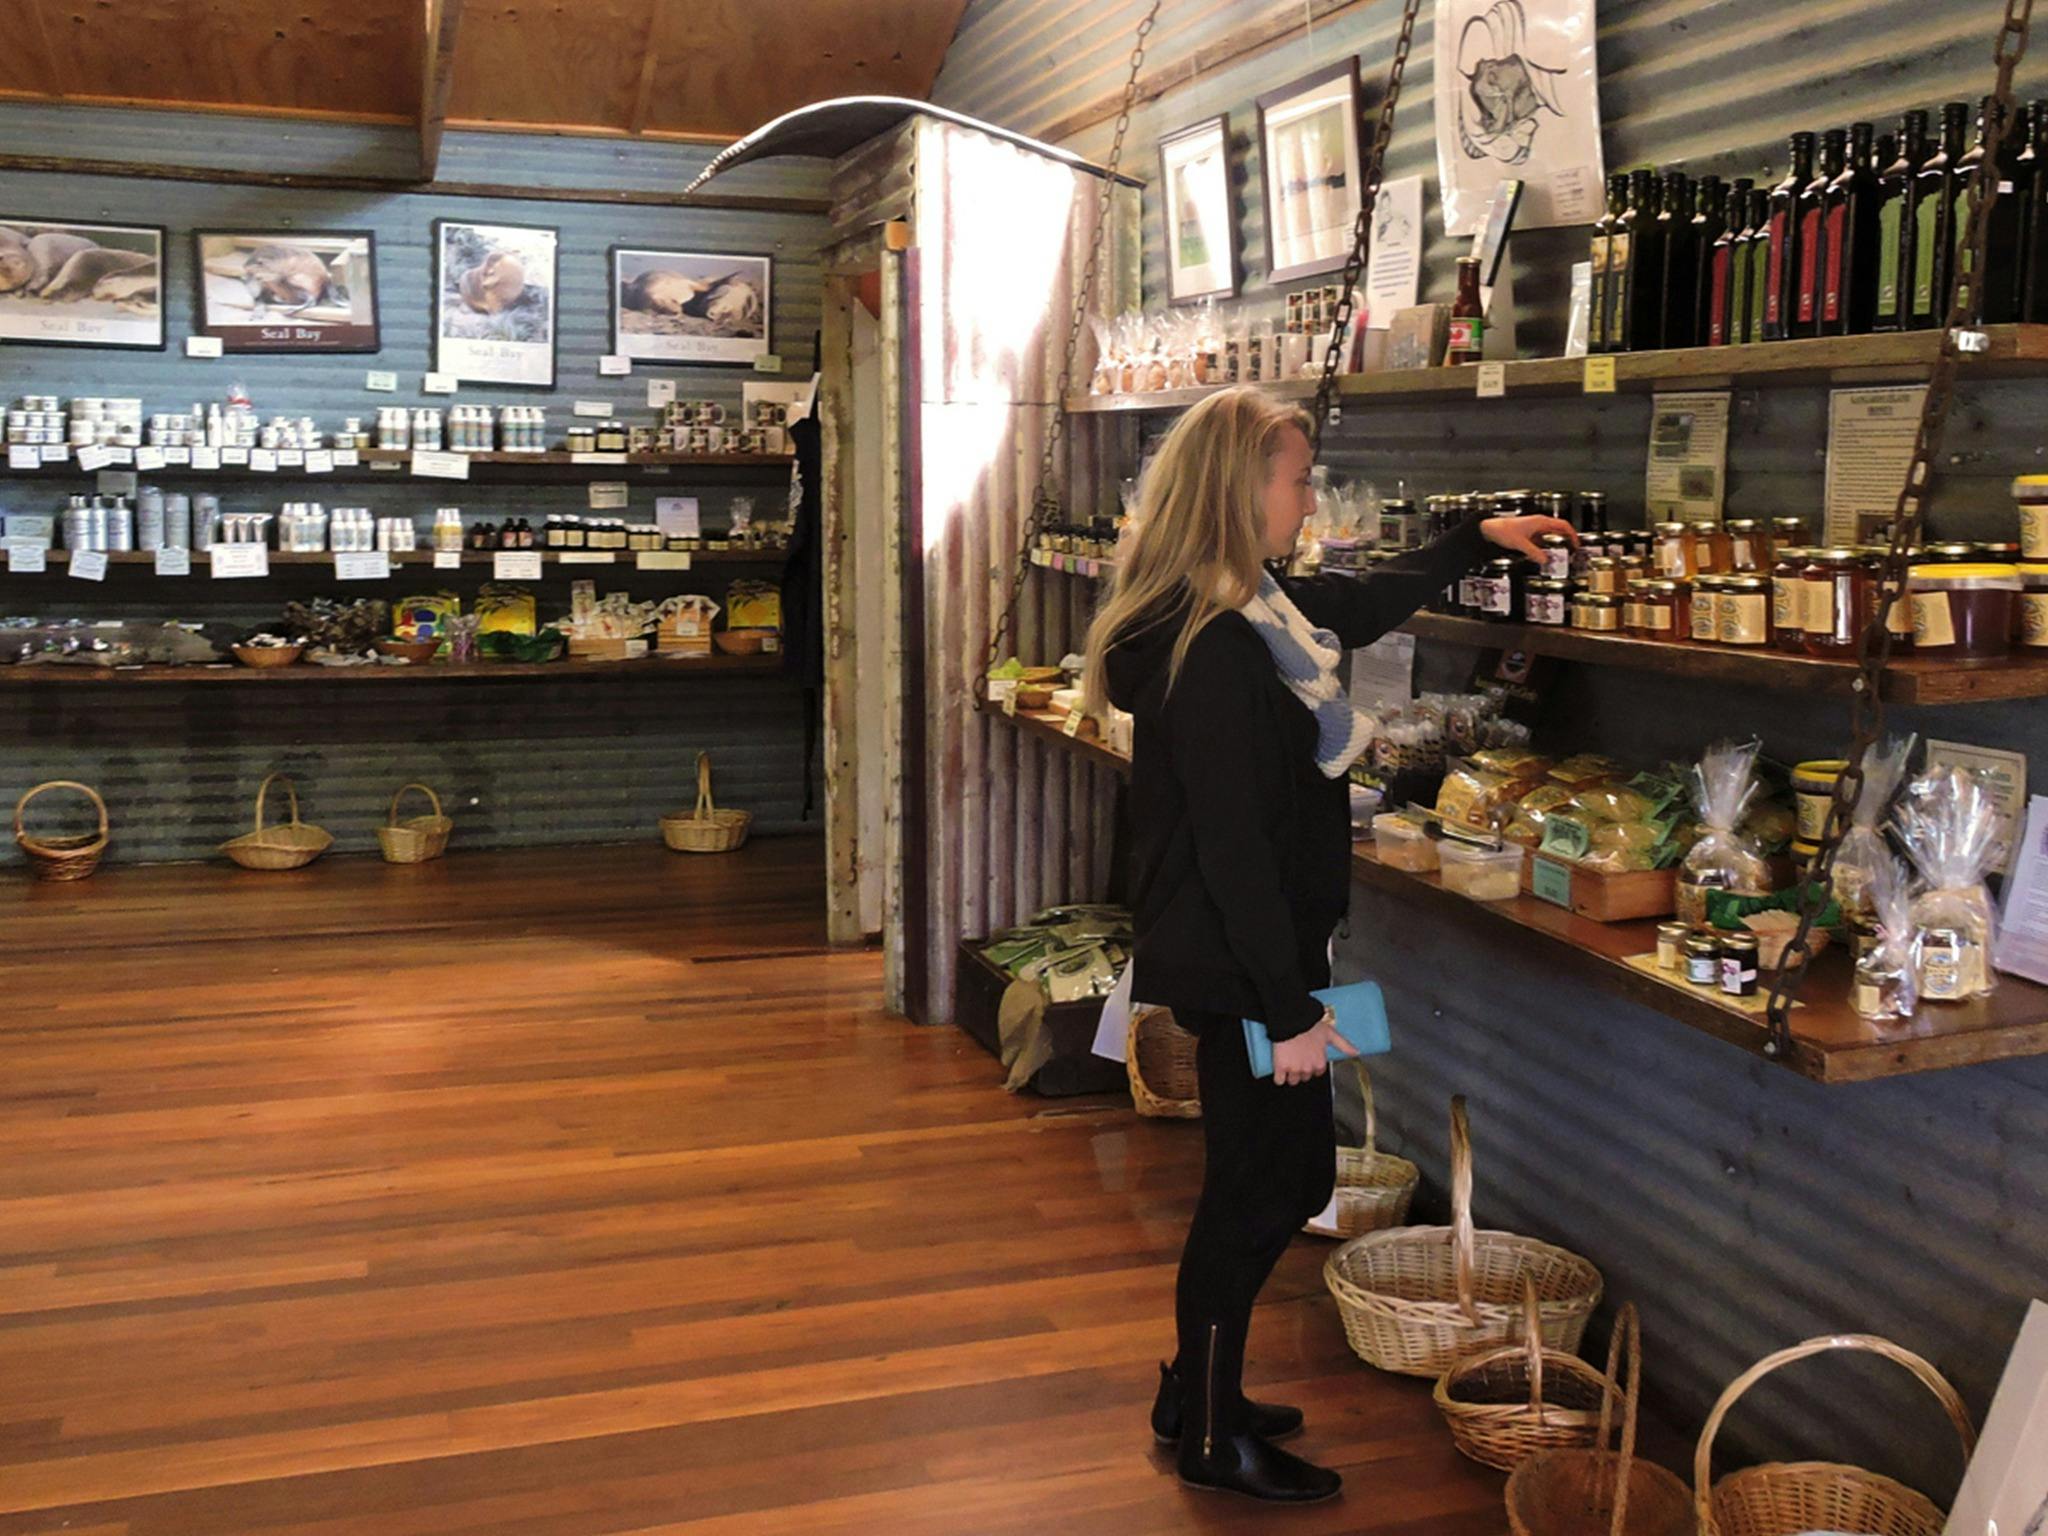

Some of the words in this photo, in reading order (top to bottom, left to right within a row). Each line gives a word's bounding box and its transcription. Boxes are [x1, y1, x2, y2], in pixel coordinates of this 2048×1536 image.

[40, 319, 69, 332] Seal
[76, 321, 103, 334] Bay
[261, 327, 290, 340] Seal
[296, 328, 322, 342] Bay
